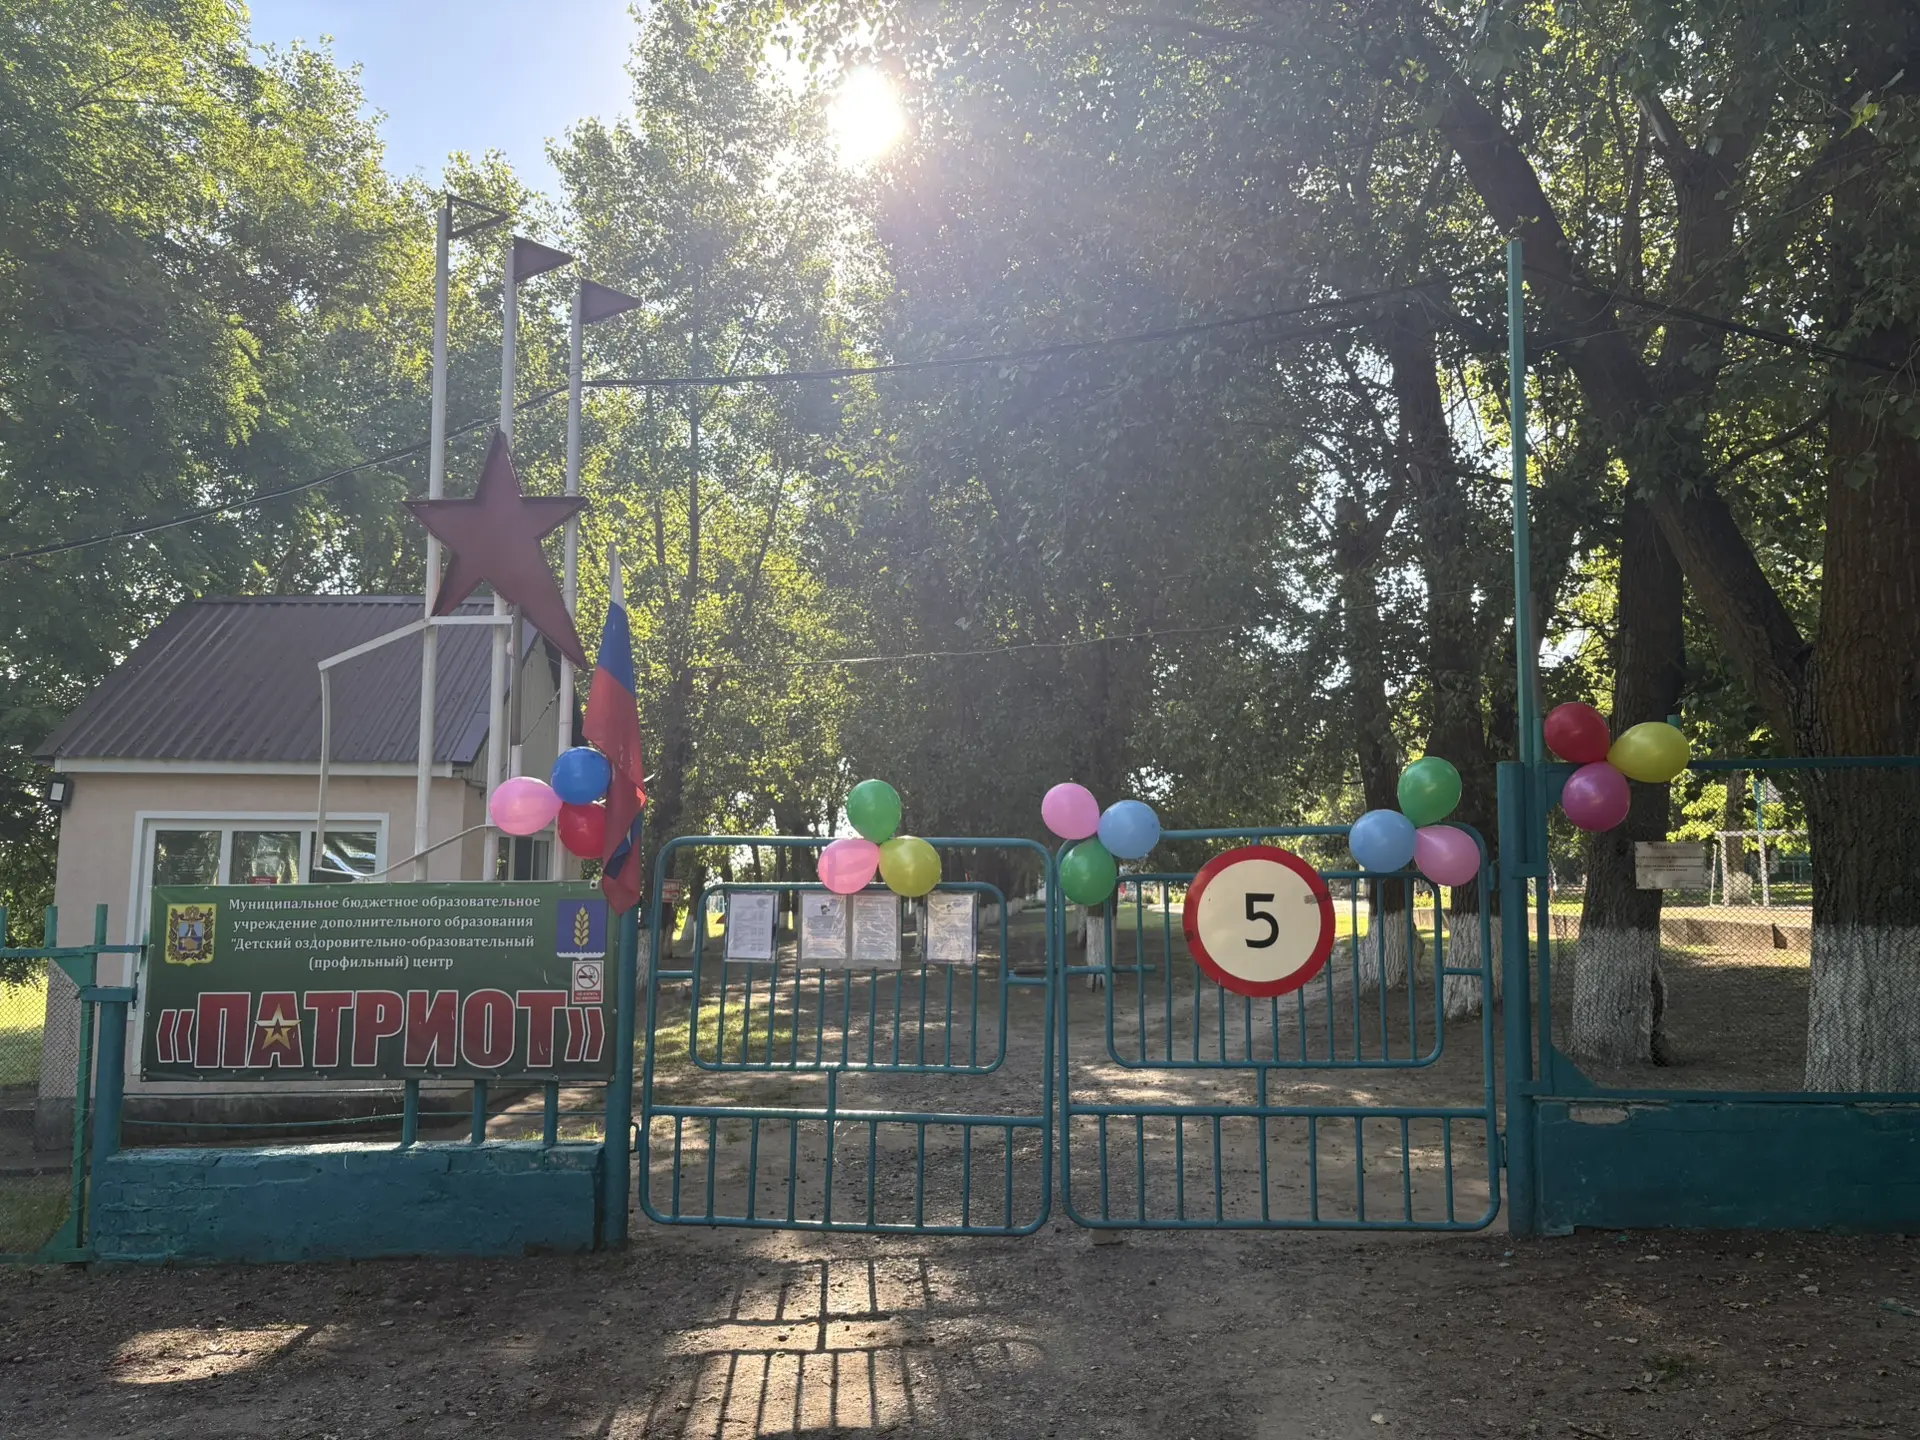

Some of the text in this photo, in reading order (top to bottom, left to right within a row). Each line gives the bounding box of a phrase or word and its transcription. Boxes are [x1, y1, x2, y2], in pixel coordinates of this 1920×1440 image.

[229, 896, 541, 912] Муниципальное бюджетное образовательное
[233, 916, 534, 932] учреждение дополнительного образования
[1245, 893, 1279, 948] 5
[295, 935, 535, 950] оздоровительно-образовательный
[309, 955, 454, 971] (профильный) центр
[156, 988, 606, 1068] «ПАТРИОТ»
